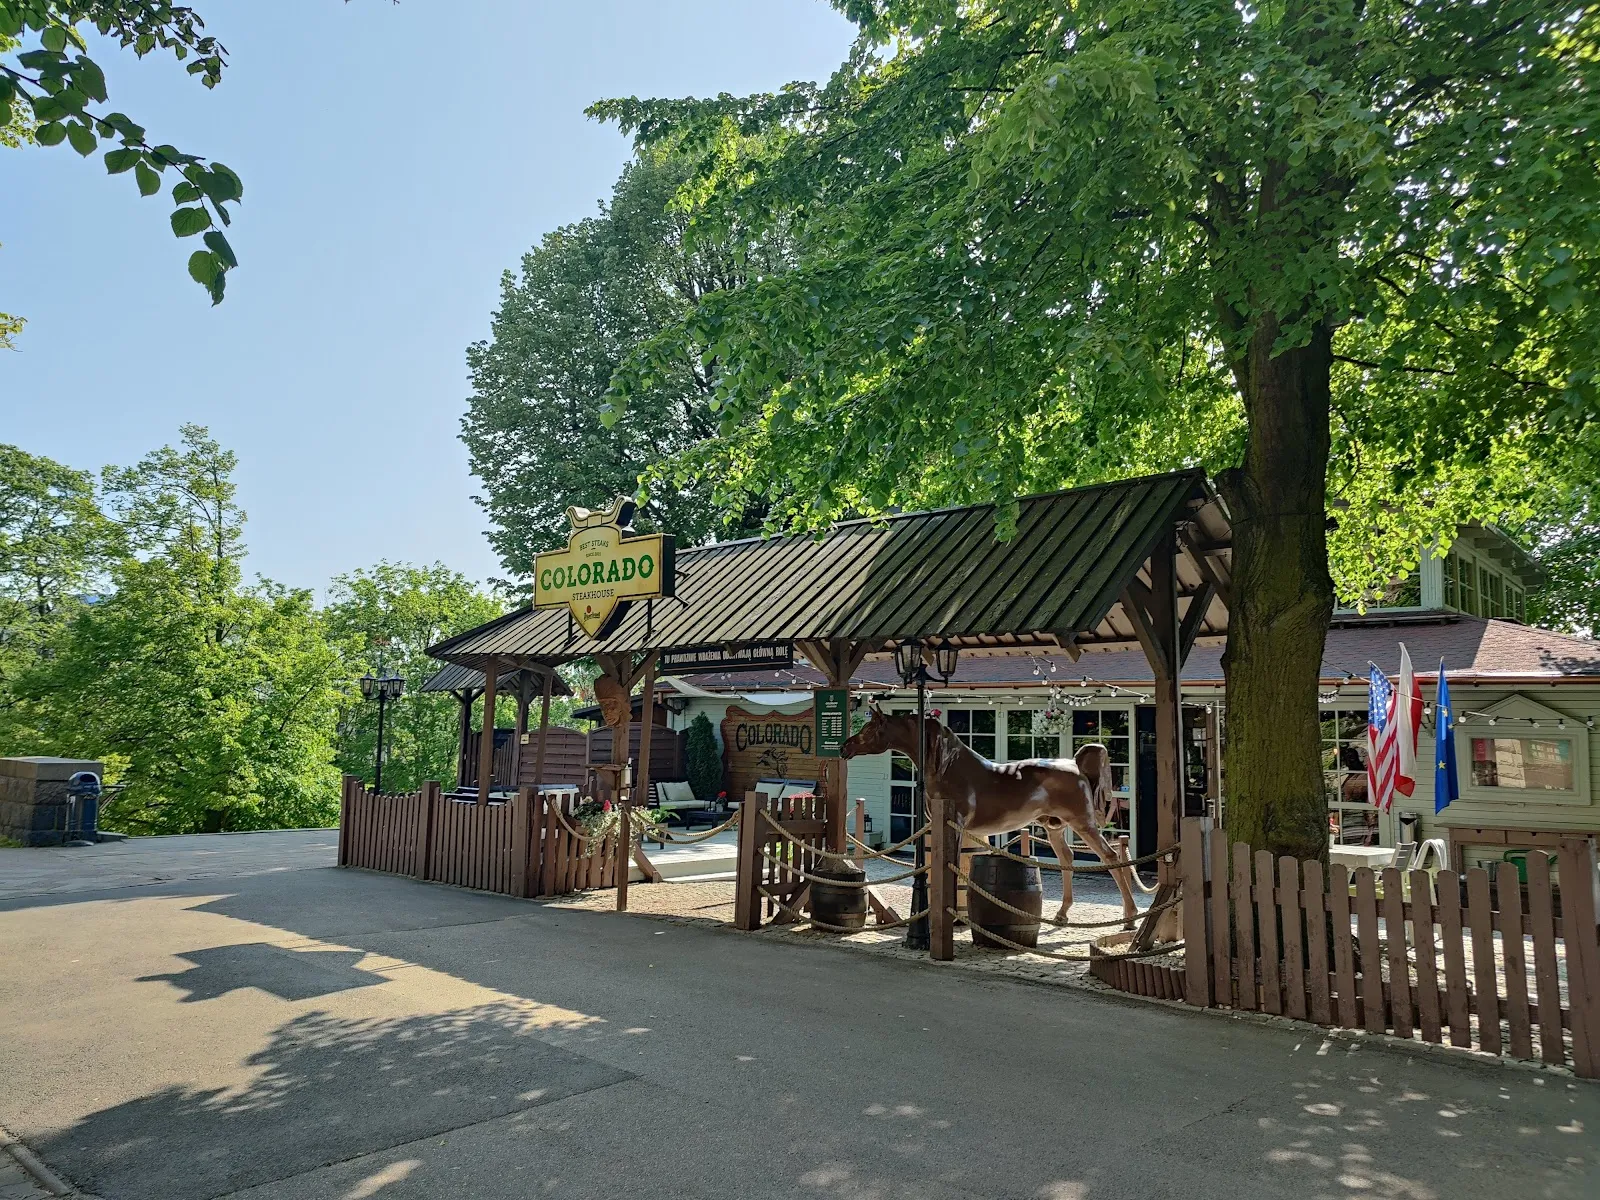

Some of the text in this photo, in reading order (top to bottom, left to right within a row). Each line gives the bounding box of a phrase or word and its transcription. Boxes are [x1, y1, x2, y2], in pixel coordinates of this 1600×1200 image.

[579, 540, 609, 551] BEST STEAKS
[540, 554, 655, 591] COLORADO
[572, 589, 615, 601] STEAKHOUSE
[697, 650, 721, 662] WRAŻENIA
[752, 645, 774, 659] GŁÓWNĄ
[775, 645, 789, 658] ROLĘ
[736, 723, 812, 754] COLORADO
